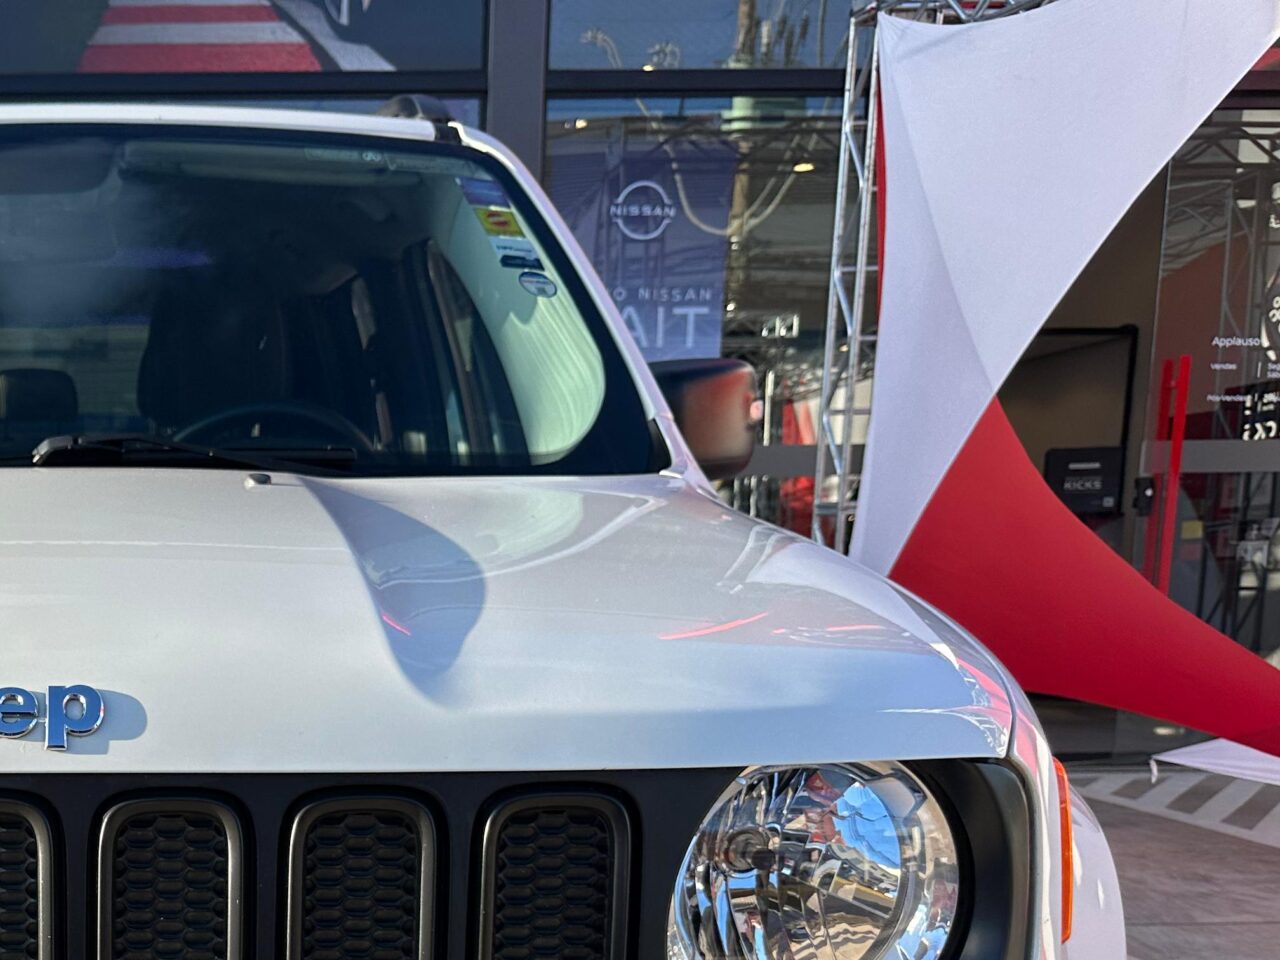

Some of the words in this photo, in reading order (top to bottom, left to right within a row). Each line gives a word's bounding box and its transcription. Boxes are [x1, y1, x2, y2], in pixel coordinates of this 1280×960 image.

[610, 204, 675, 218] NISSAN
[638, 287, 711, 302] NISSAN
[1211, 336, 1260, 348] Applauso
